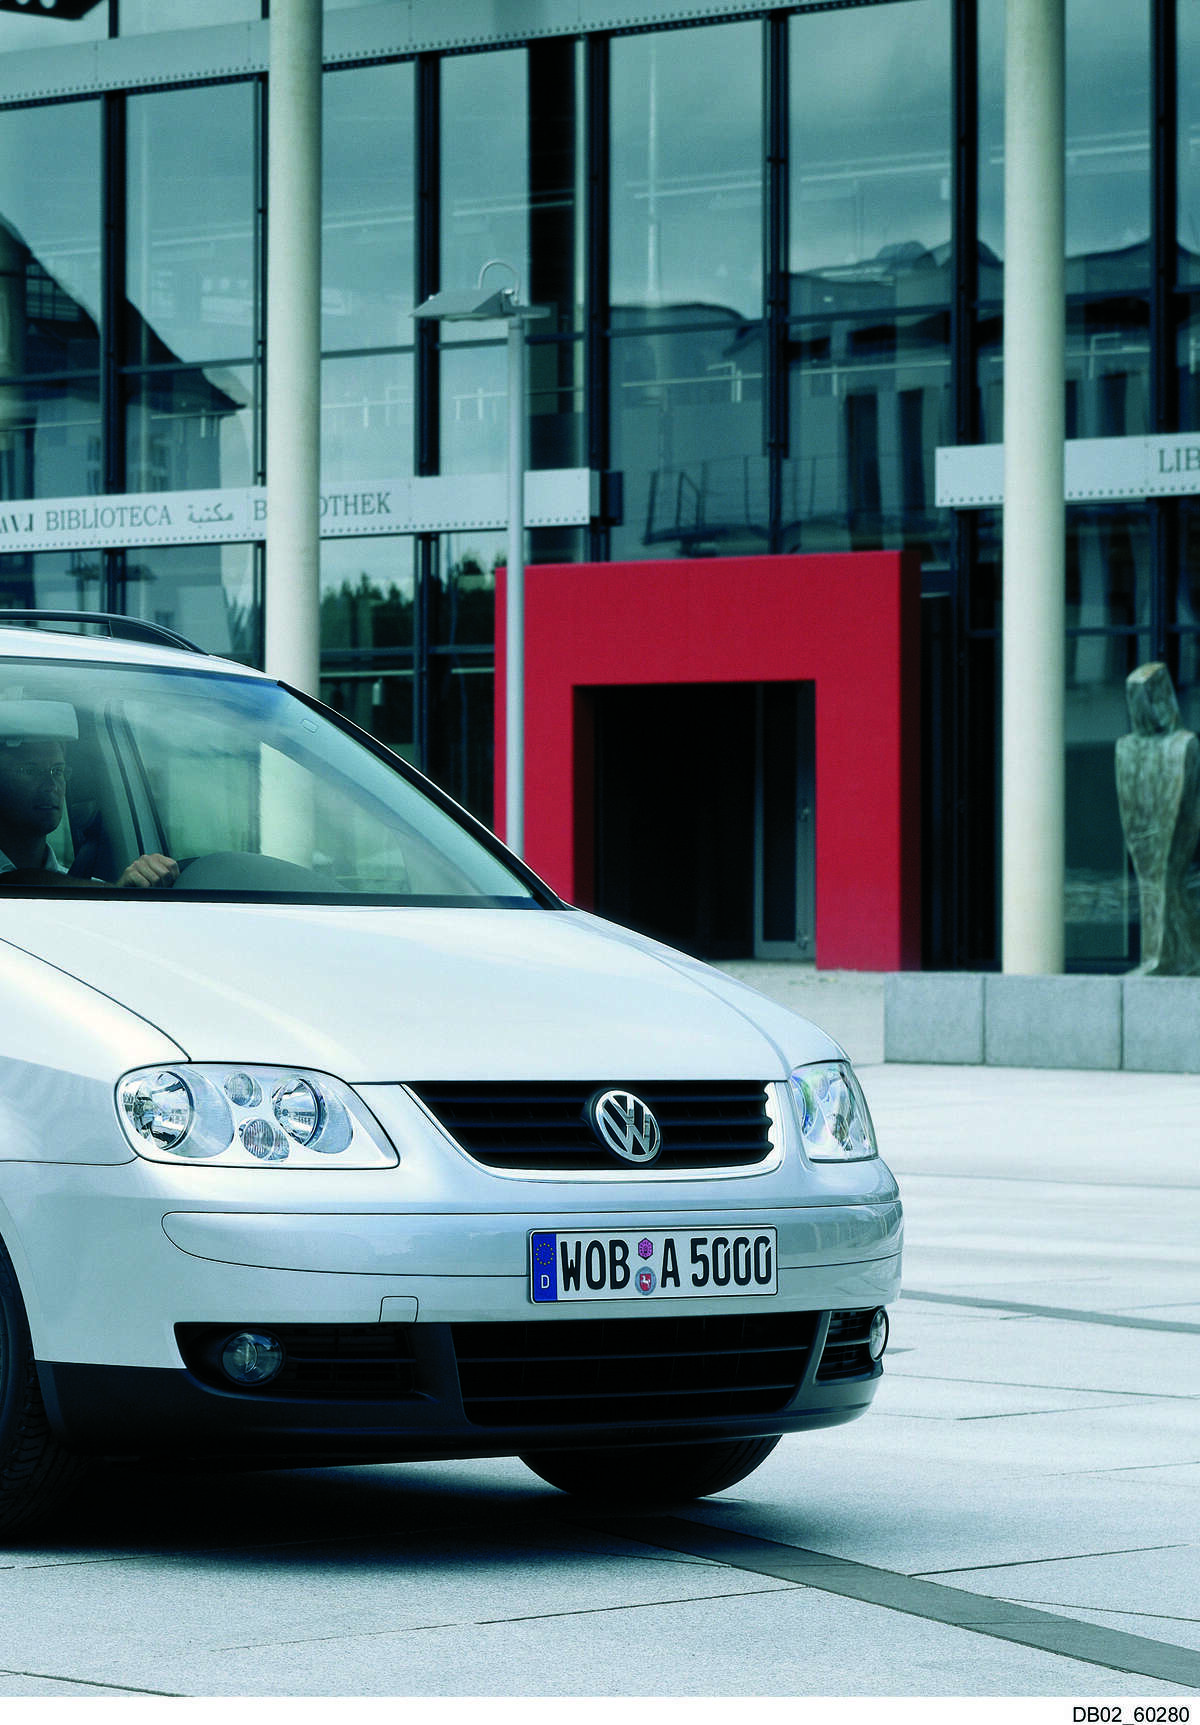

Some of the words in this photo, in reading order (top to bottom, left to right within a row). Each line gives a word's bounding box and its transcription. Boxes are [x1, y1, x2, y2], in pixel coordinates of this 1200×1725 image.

[1159, 448, 1200, 472] LIB
[45, 505, 172, 532] BIBLIOTECA
[187, 503, 234, 525] مكتبة
[595, 1090, 660, 1163] VW
[560, 1239, 631, 1291] WOB
[660, 1238, 681, 1288] A
[690, 1236, 772, 1287] 5000
[540, 1274, 550, 1289] D
